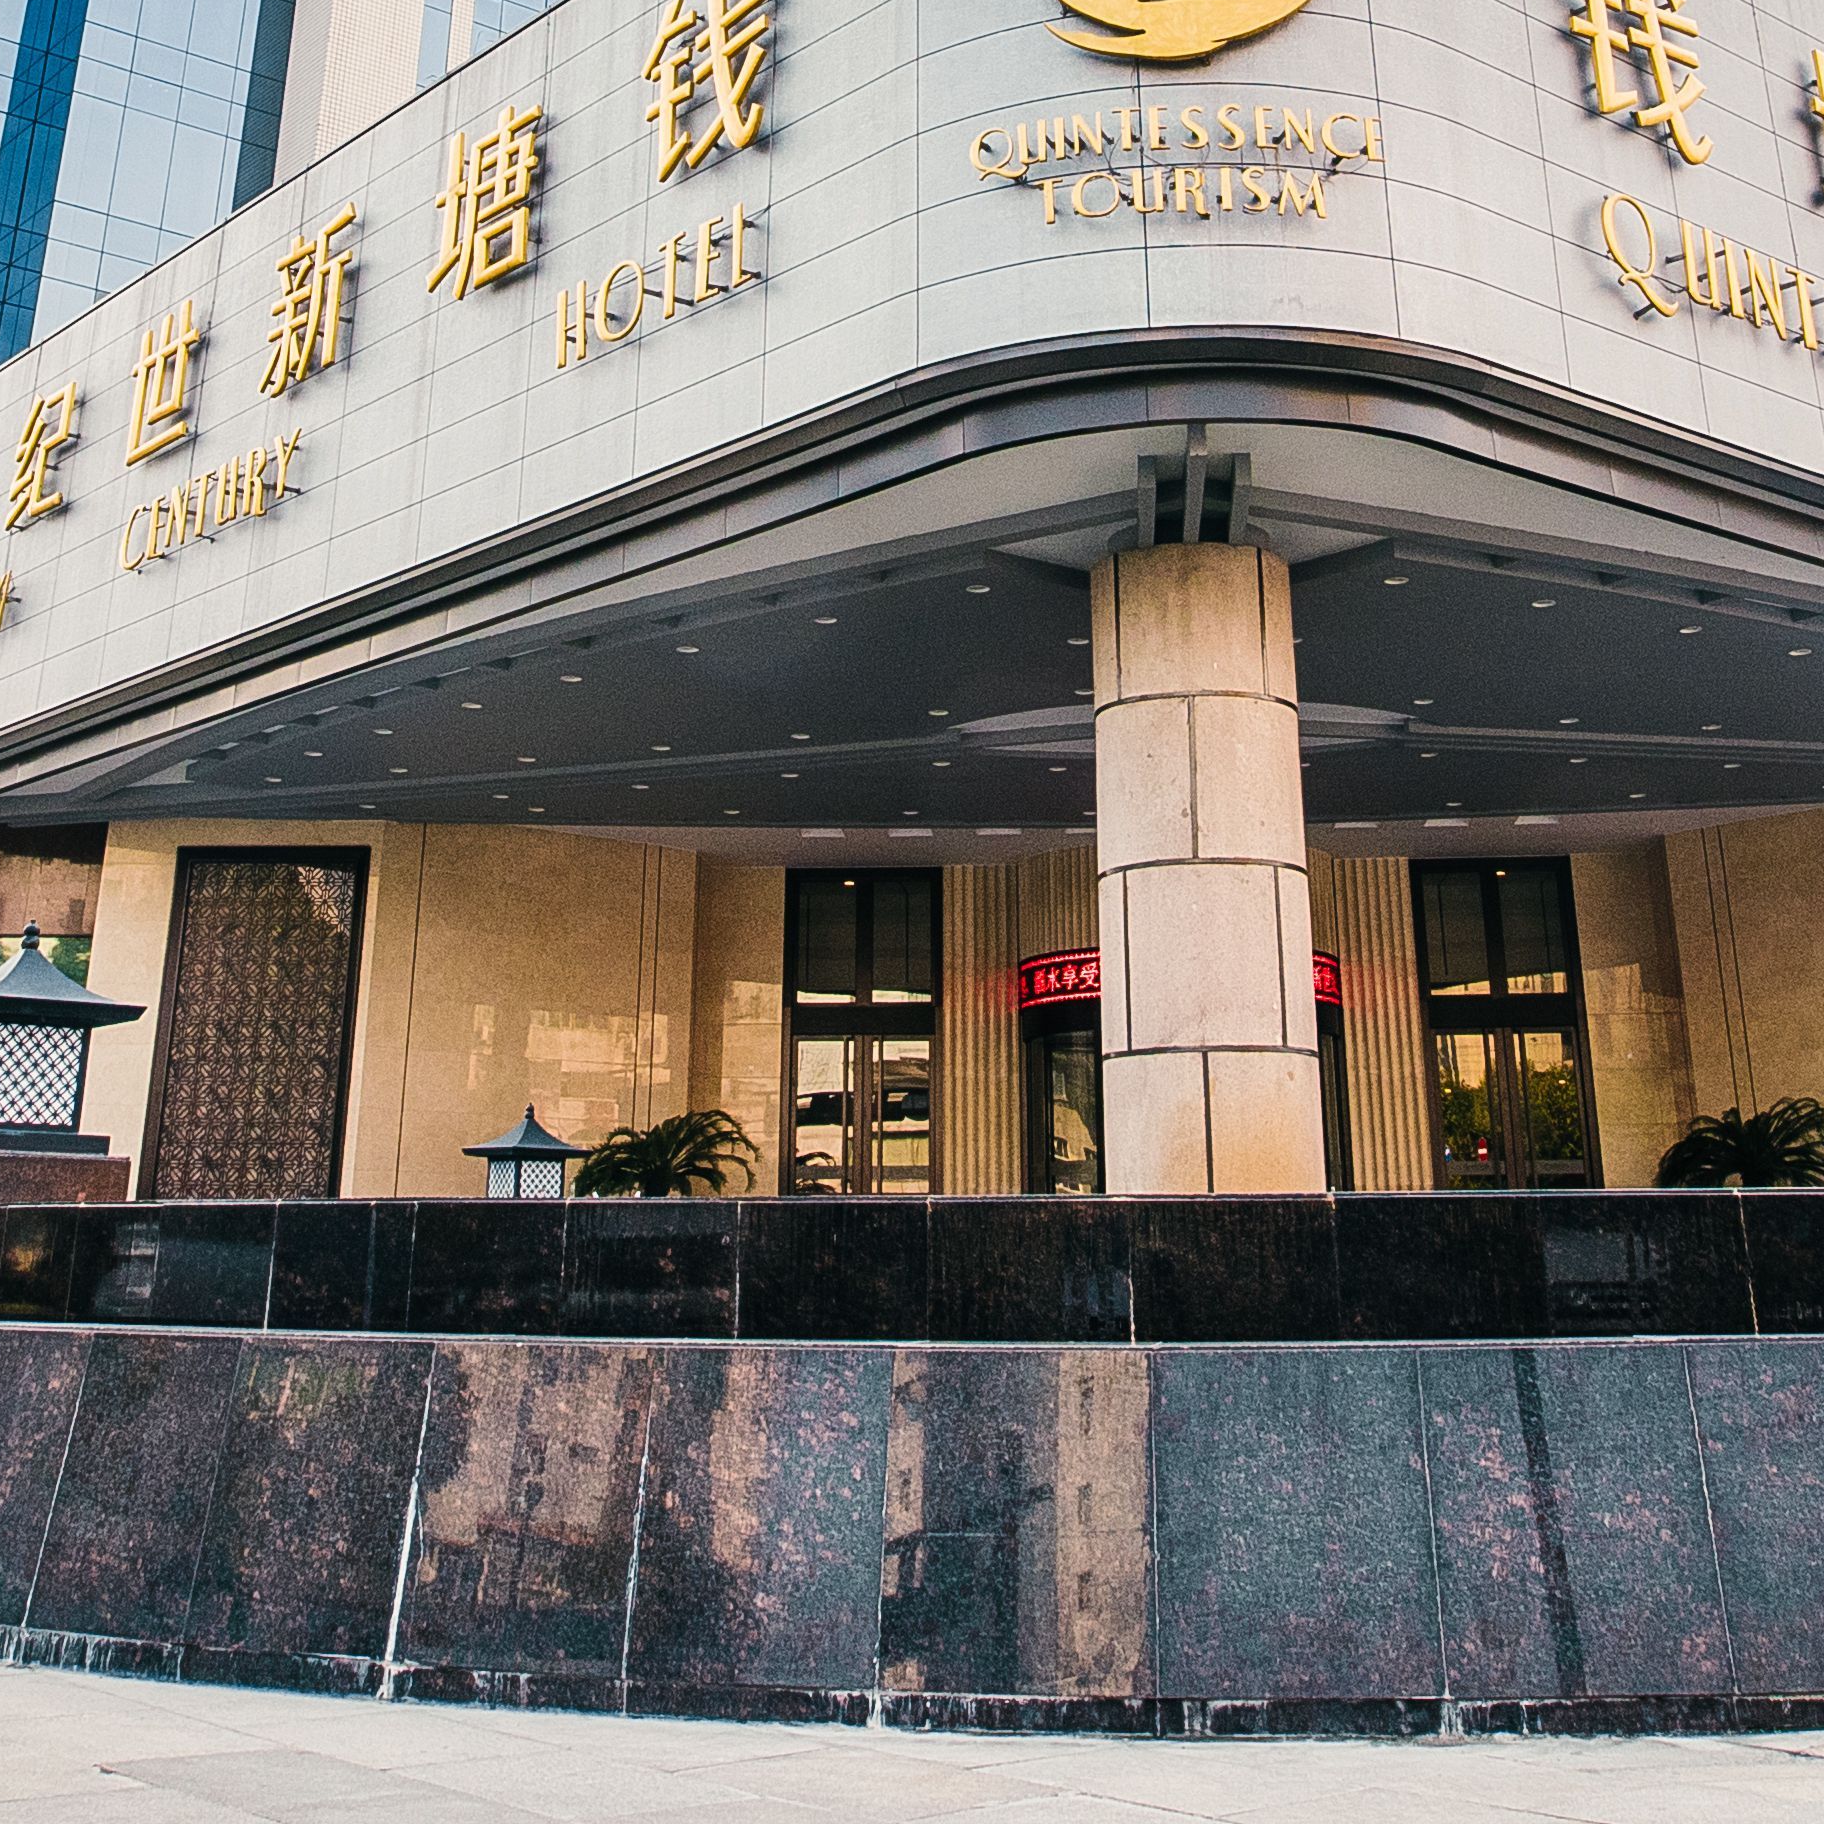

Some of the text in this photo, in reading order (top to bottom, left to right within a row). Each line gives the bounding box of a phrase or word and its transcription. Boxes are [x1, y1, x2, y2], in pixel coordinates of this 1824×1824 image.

[969, 102, 1387, 181] QUINTESSENCE
[1035, 165, 1328, 225] TOURISM
[118, 427, 303, 572] CENTURY
[556, 202, 753, 369] HOTEL
